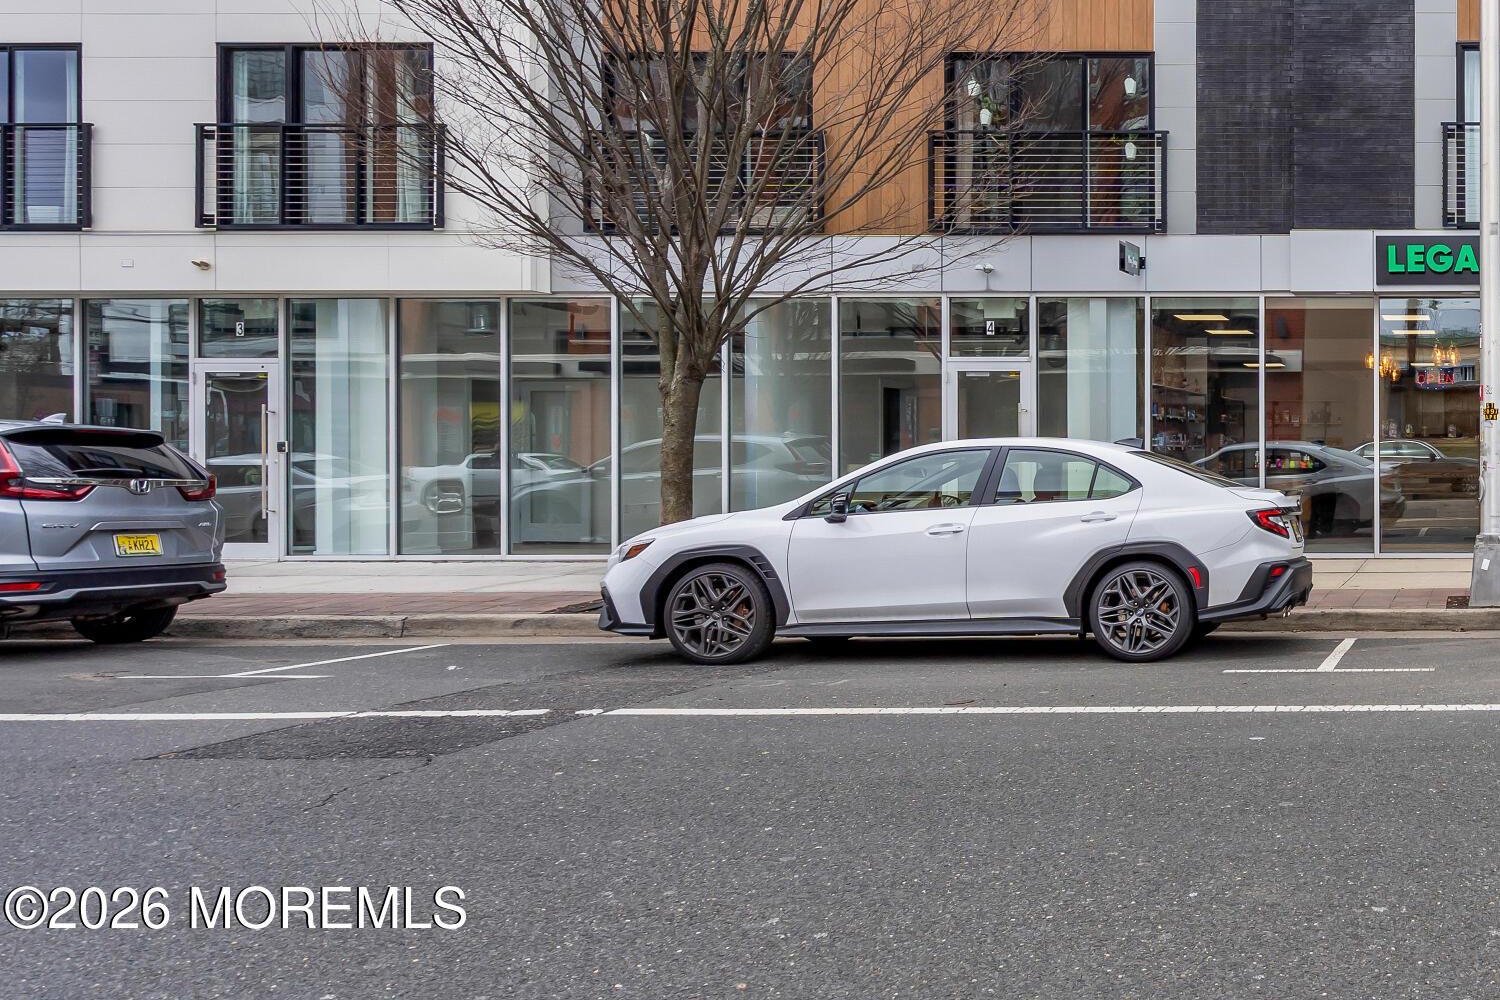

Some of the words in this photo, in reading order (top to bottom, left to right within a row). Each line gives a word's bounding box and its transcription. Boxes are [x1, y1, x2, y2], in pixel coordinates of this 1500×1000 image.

[1387, 244, 1480, 273] LEGA
[237, 322, 244, 336] 3
[987, 321, 994, 334] 4
[1416, 372, 1455, 385] OPEN
